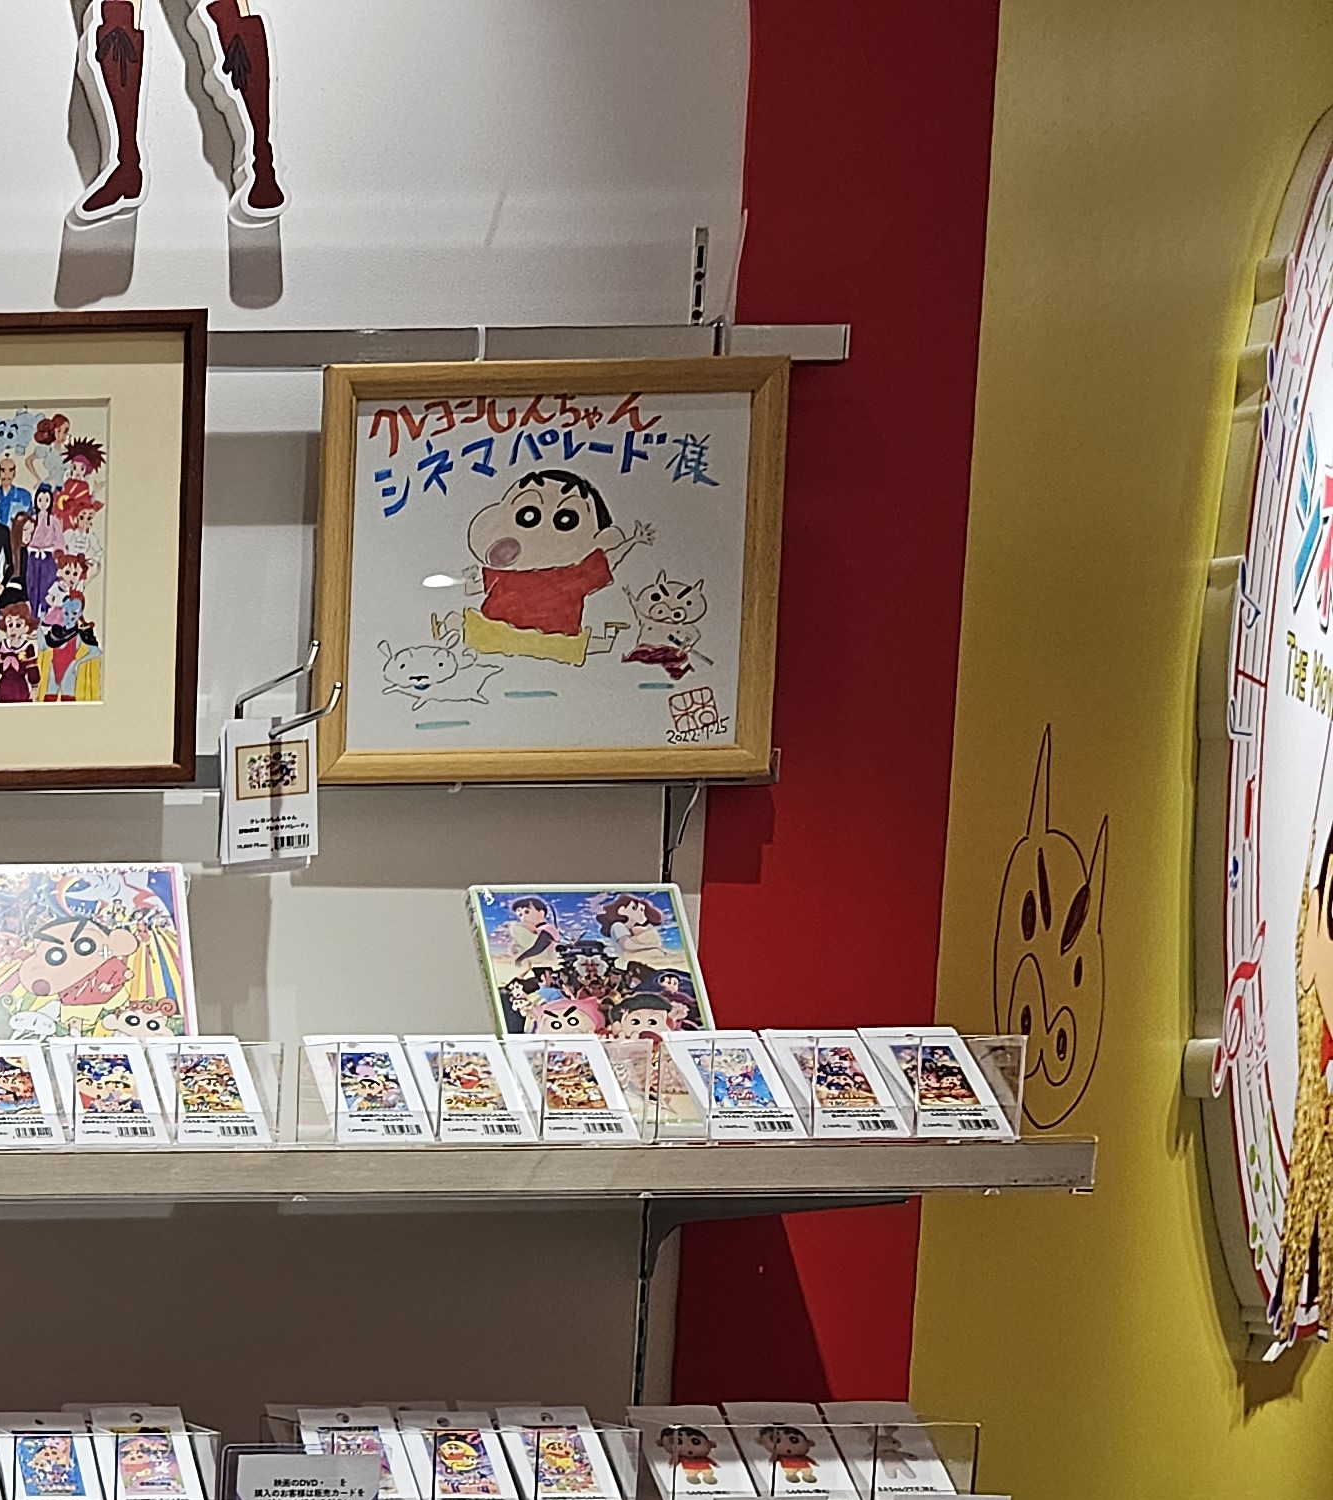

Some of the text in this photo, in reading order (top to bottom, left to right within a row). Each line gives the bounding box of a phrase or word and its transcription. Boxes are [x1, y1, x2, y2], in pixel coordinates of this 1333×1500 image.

[369, 391, 663, 457] クレヨンしんちゃん
[1286, 630, 1308, 702] THE
[254, 1487, 365, 1498] 購入のお客様は販売カードを
